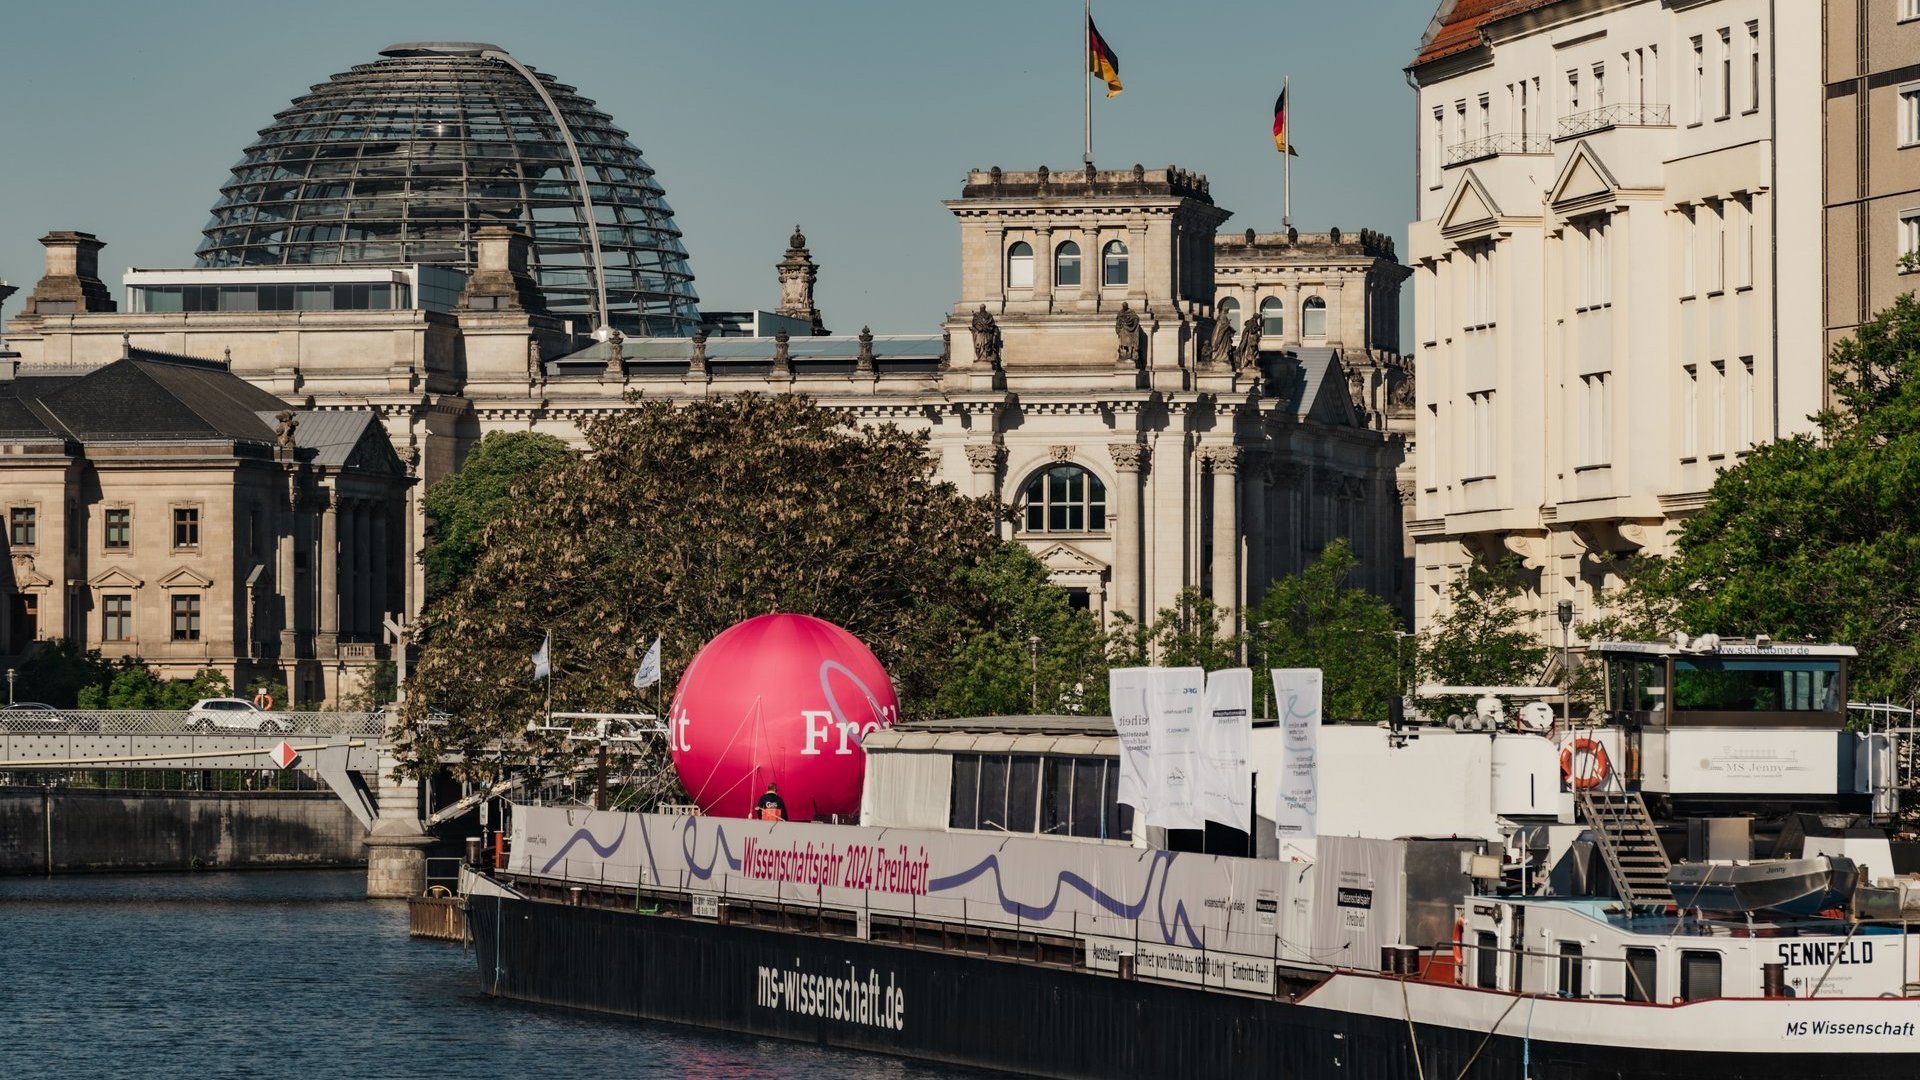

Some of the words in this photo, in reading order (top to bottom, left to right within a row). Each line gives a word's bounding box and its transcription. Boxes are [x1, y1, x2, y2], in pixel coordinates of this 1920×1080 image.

[1726, 763, 1745, 772] MS
[1749, 763, 1784, 774] Jenny
[743, 836, 844, 895] Wissenschaftsjahr
[846, 846, 873, 890] 2024
[874, 846, 930, 896] Freiheit
[1765, 865, 1787, 875] Jenny
[1092, 942, 1123, 963] Ausstellun
[1184, 954, 1194, 974] bis
[1211, 959, 1224, 978] Uhr
[1232, 962, 1254, 982] Eintritt
[1255, 963, 1269, 984] frei!
[1778, 941, 1873, 967] SENNFELD
[757, 957, 905, 1031] ms-wissenschaft.de
[1786, 1022, 1808, 1036] MS
[1812, 1021, 1915, 1037] Wissenschaft
